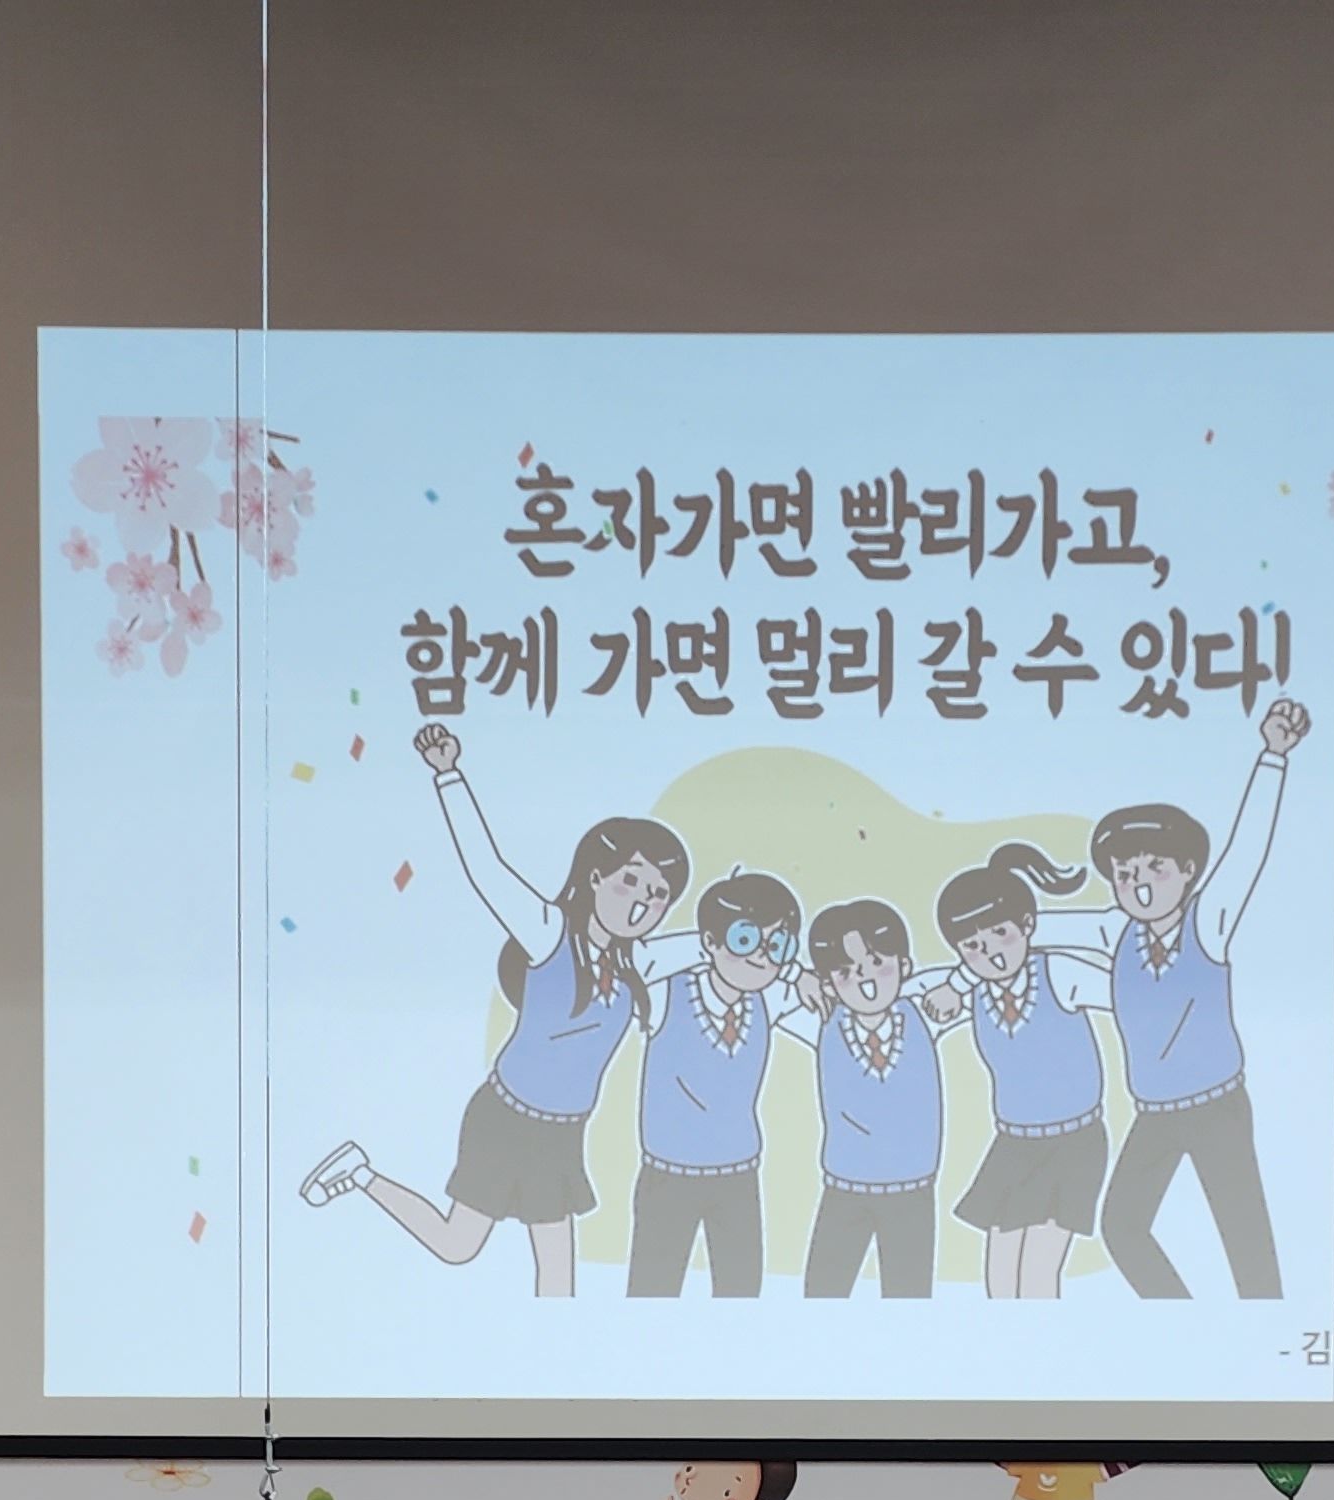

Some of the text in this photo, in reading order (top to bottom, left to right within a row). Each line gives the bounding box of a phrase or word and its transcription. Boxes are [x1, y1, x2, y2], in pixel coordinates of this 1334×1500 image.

[504, 462, 1170, 589] 혼자가면 빨리가고,
[400, 605, 1290, 719] 함께 가면 멀리 갈 수 있다!
